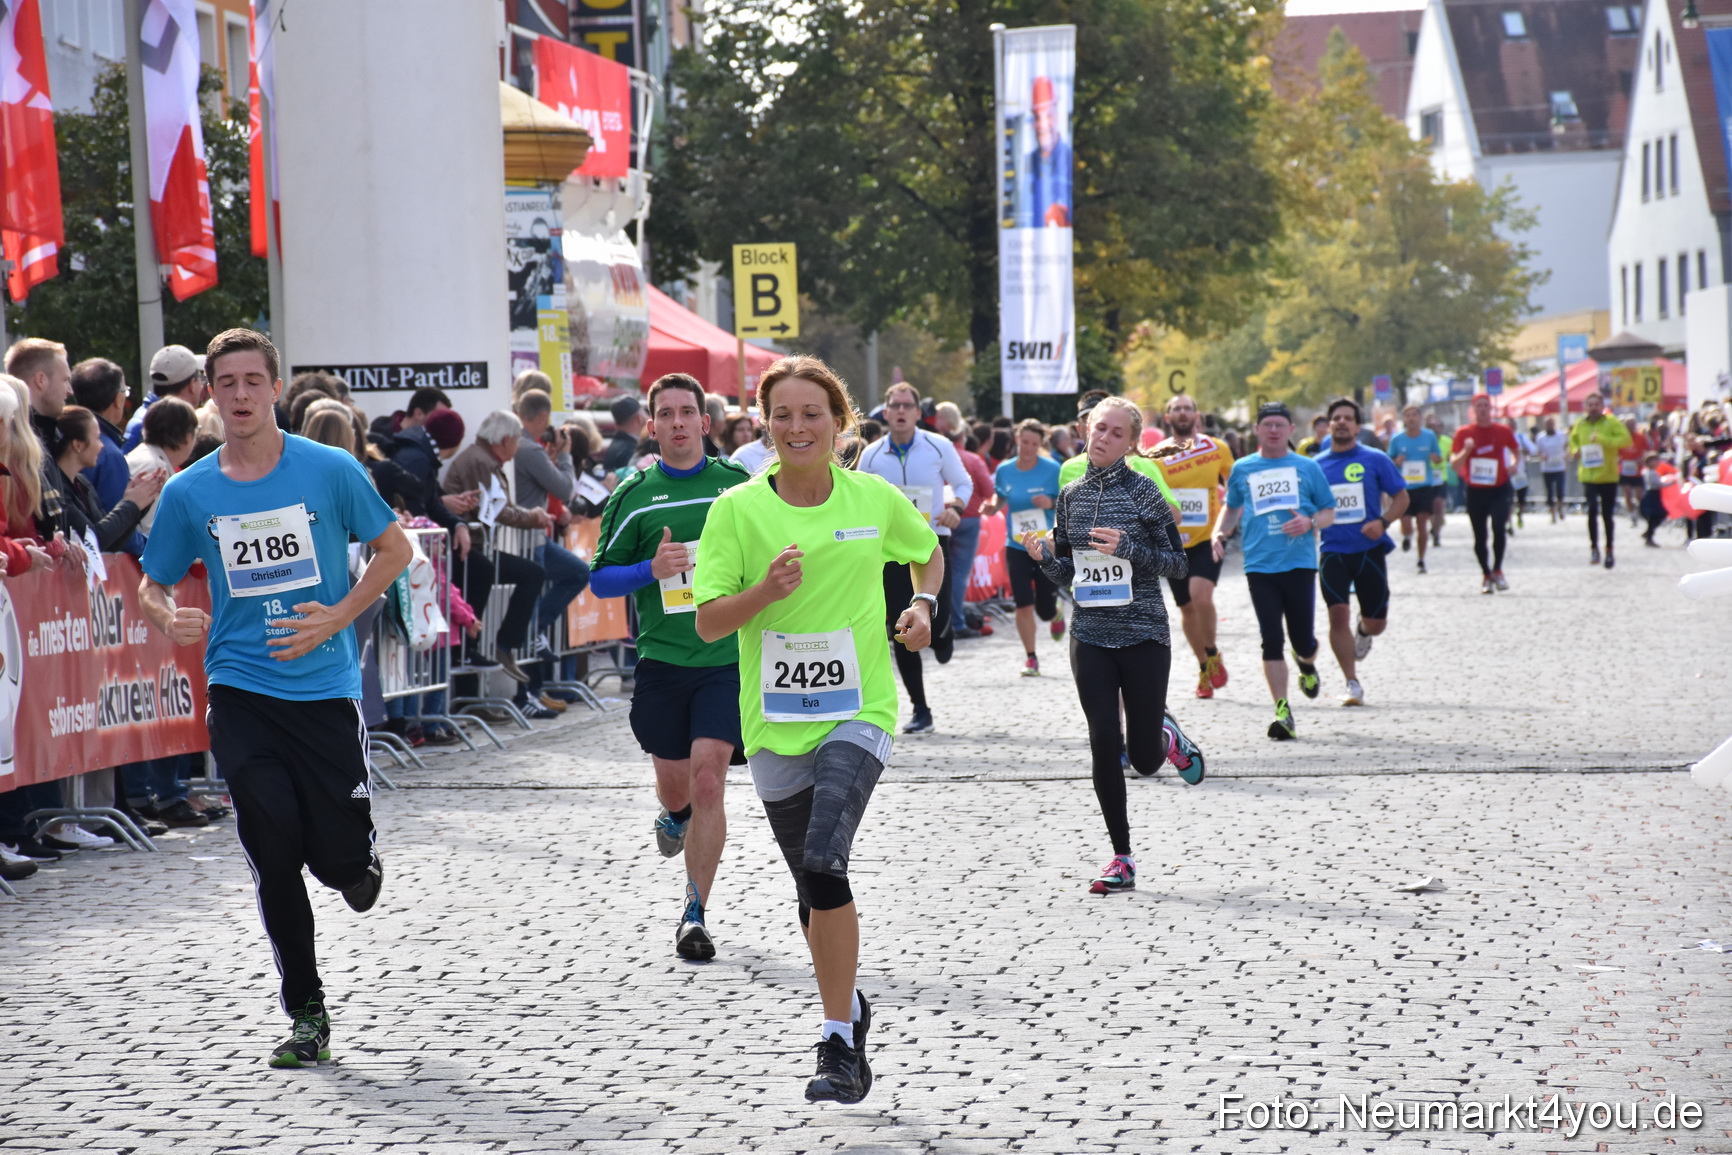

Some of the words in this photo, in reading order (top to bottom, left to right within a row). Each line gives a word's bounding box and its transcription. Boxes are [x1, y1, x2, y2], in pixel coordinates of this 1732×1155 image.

[740, 247, 788, 265] Block
[751, 272, 782, 317] B
[1007, 341, 1053, 360] swn
[333, 365, 481, 388] MINI-Partl.de
[1168, 369, 1186, 395] C
[1644, 376, 1658, 396] D
[651, 494, 669, 502] JAKO
[1257, 480, 1291, 498] 2323
[249, 517, 281, 529] BOCK
[233, 533, 300, 566] 2186
[251, 567, 293, 583] Christian
[1081, 564, 1124, 583] 2419
[1089, 588, 1112, 596] Jessica
[262, 599, 288, 616] 18.
[794, 641, 829, 651] BOCK
[774, 659, 845, 689] 2429
[160, 663, 193, 717] Hits
[802, 697, 820, 708] Eva
